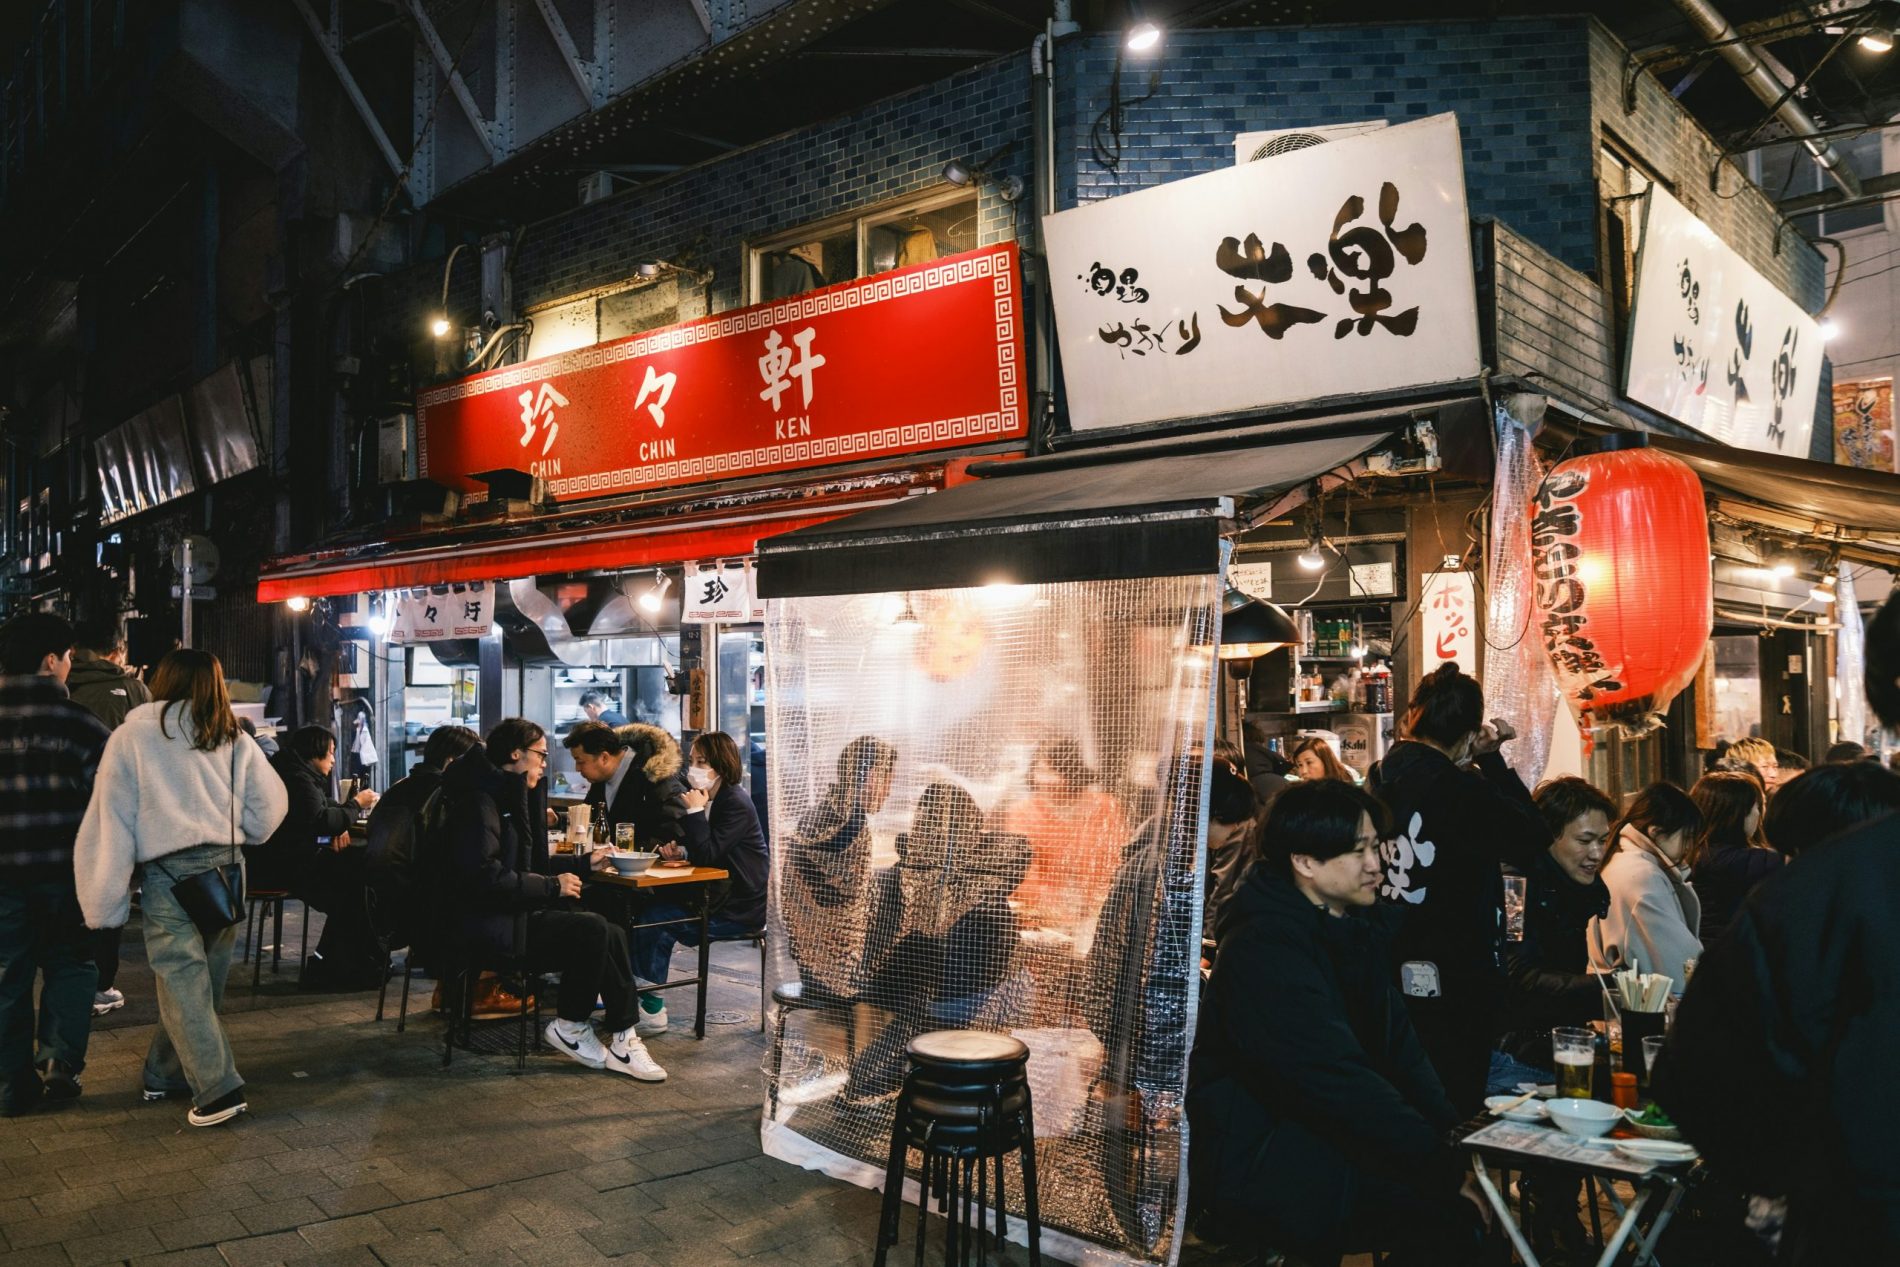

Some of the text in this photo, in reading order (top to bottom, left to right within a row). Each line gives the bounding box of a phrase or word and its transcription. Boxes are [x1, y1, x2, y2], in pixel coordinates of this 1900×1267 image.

[530, 415, 811, 478] CHIN CHIN KEN
[699, 575, 729, 604] 珍
